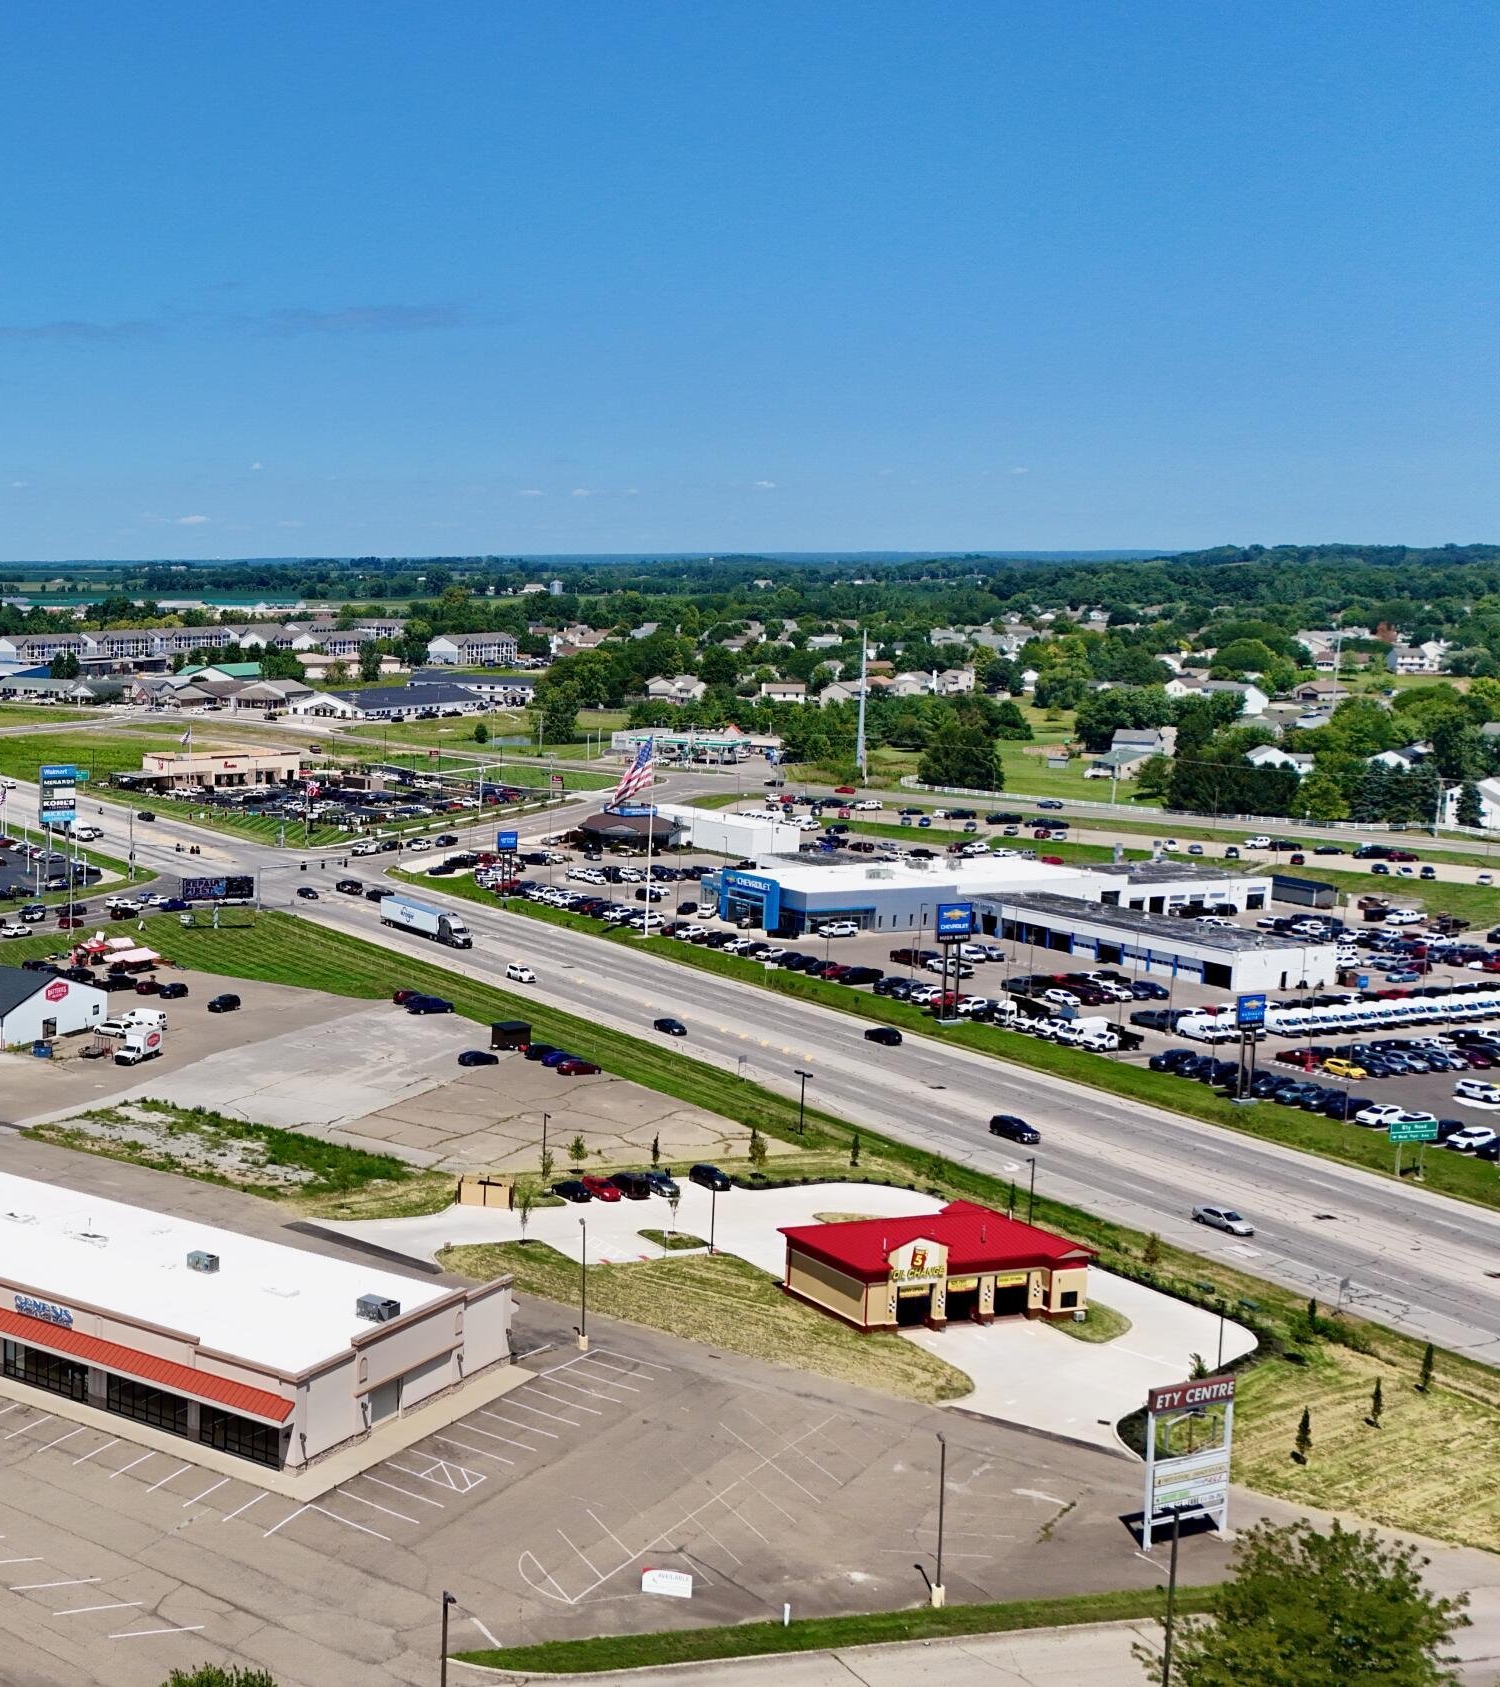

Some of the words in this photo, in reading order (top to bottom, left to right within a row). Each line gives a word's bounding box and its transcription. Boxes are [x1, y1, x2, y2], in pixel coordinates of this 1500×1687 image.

[737, 877, 771, 891] CHEVROLET
[913, 1254, 923, 1266] 5
[892, 1269, 905, 1281] OIL
[907, 1265, 945, 1281] CHANGE
[14, 1295, 73, 1323] GENESIS
[1156, 1391, 1182, 1409] ETY
[1185, 1381, 1235, 1403] CENTRE
[658, 1572, 690, 1583] AVAILABLE
